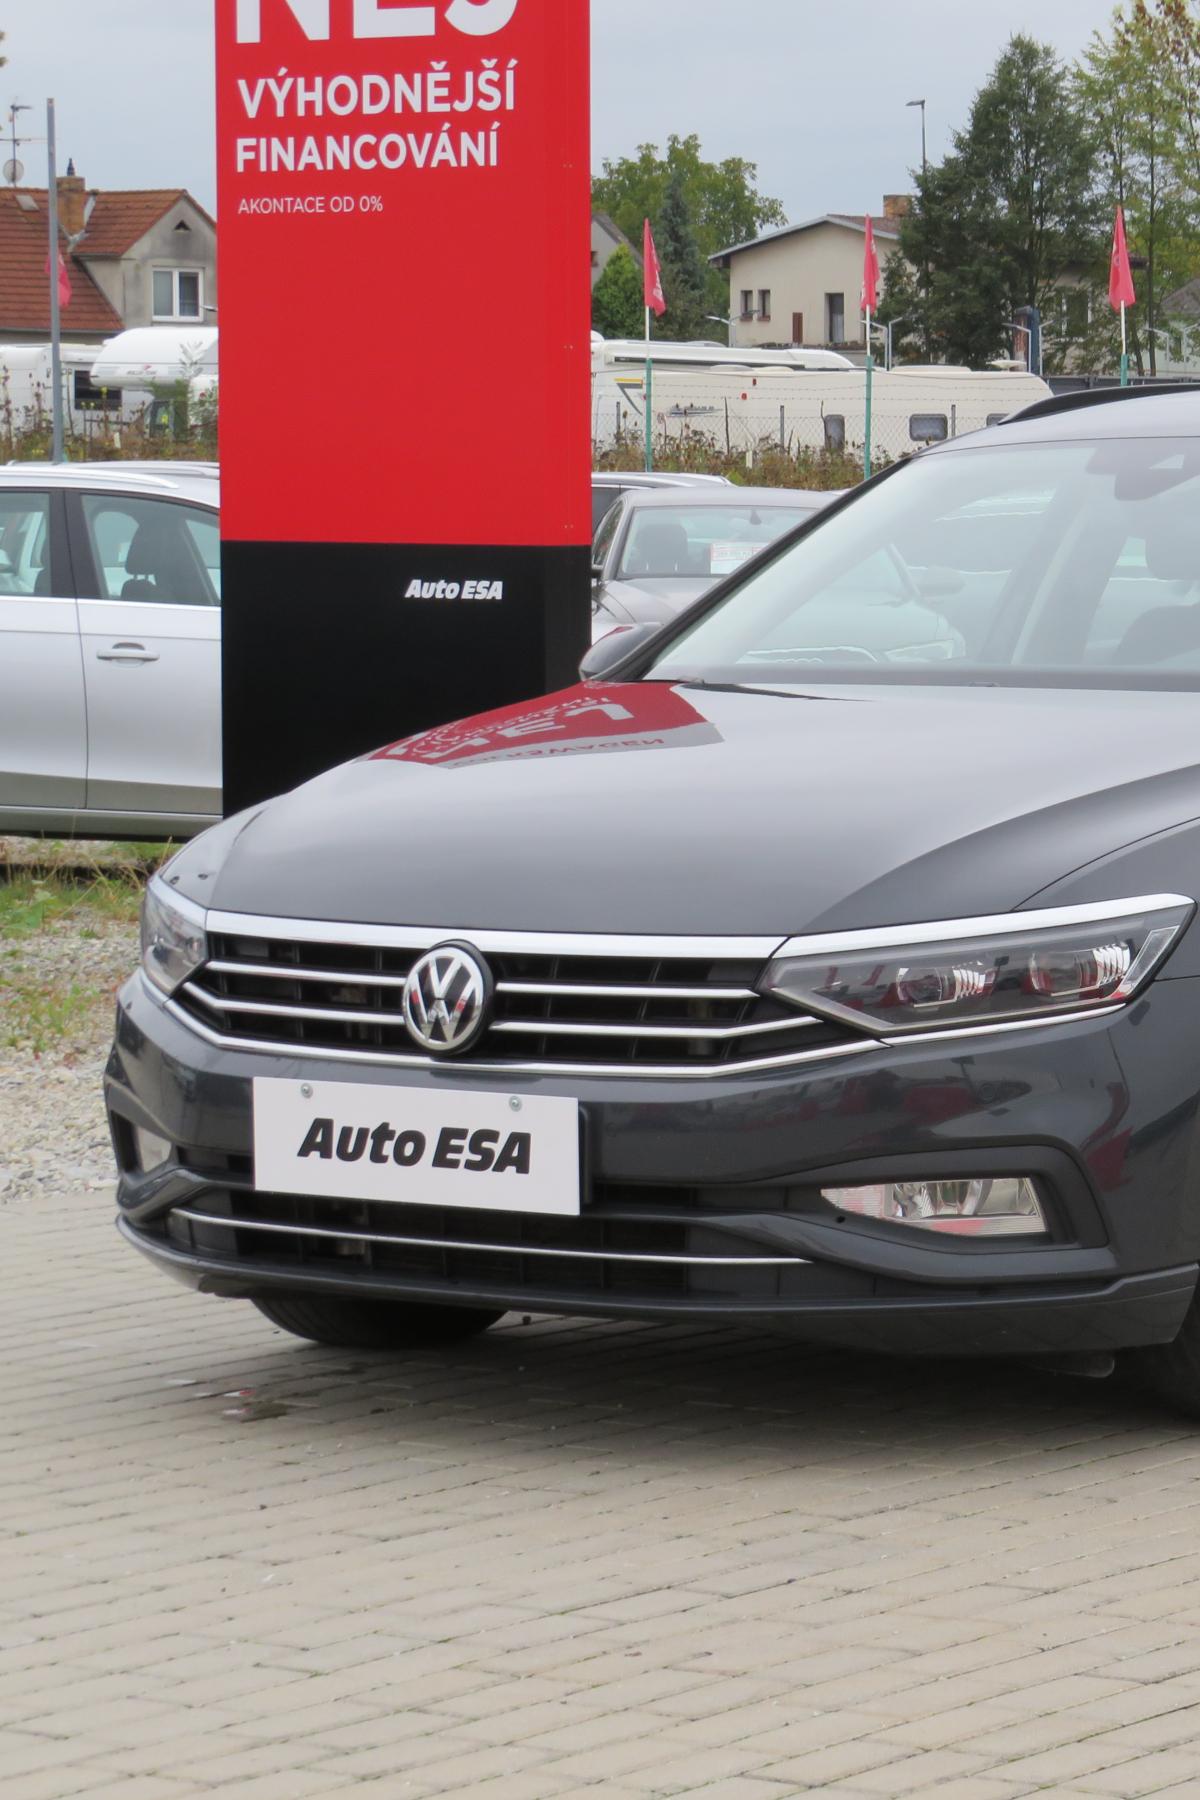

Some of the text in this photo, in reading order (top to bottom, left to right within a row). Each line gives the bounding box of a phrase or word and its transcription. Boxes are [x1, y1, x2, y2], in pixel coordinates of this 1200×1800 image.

[237, 58, 519, 119] VÝHODNĚJŠÍ
[236, 121, 501, 172] FINANCOVÁNÍ
[238, 195, 384, 215] AKONTACE OD 0%
[404, 579, 503, 600] Auto ESA
[297, 1117, 531, 1174] Auto ESA
